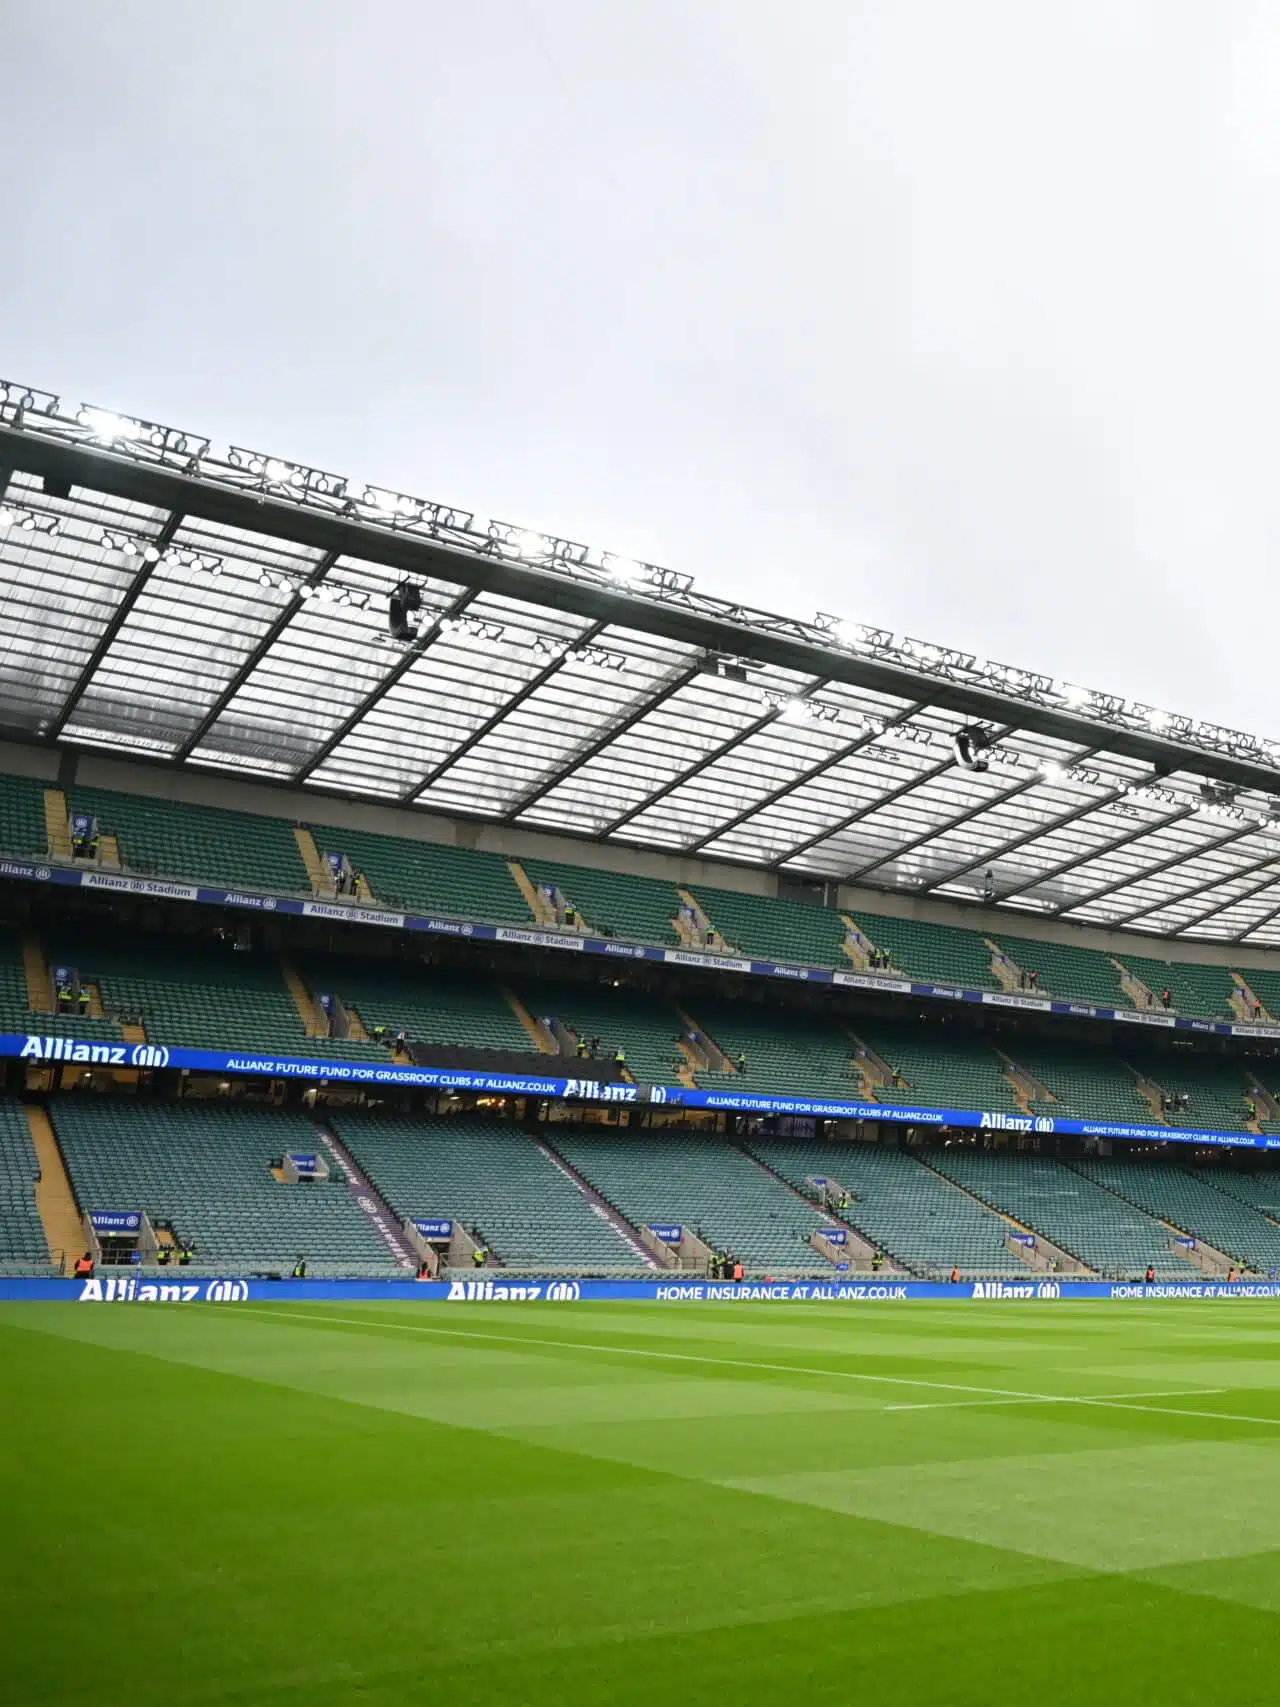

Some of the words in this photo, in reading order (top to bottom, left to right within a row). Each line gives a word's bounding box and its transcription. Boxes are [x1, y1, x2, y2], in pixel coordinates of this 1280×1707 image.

[0, 863, 33, 877] llianz
[89, 875, 128, 889] Allianz
[146, 882, 191, 897] Stadium
[224, 893, 262, 906] Allianz
[310, 904, 345, 918] Allianz
[359, 911, 399, 924] Stadium
[428, 920, 459, 933] Allianz
[501, 929, 532, 941] Allianz
[545, 935, 580, 948] Stadium
[605, 944, 633, 955] Allianz
[674, 953, 701, 964] Allianz
[712, 957, 743, 969] Stadium
[774, 966, 799, 977] Allianz
[843, 975, 866, 986] Allianz
[876, 979, 904, 990] Stadium
[932, 987, 954, 997] Allianz
[991, 995, 1011, 1005] Allianz
[1020, 998, 1044, 1008] Stadium
[1069, 1005, 1089, 1014] Allianz
[1121, 1012, 1141, 1021] Allianz
[1147, 1015, 1169, 1024] Stadium
[20, 1036, 126, 1064] Allianz
[227, 1059, 273, 1072] ALLIANZ
[275, 1063, 318, 1075] FUTURE
[320, 1066, 350, 1077] FUND
[352, 1069, 374, 1079] FOR
[376, 1071, 437, 1084] GRASSROOT
[440, 1076, 471, 1087] CLUBS
[473, 1078, 486, 1088] AT
[487, 1080, 556, 1093] ALLIANZ.CO.UK
[706, 1096, 740, 1106] ALLIANZ
[741, 1099, 771, 1109] FUTURE
[772, 1102, 794, 1111] FUND
[796, 1103, 812, 1112] FOR
[813, 1104, 857, 1115] GRASSROOT
[859, 1108, 881, 1117] CLUBS
[882, 1109, 892, 1118] AT
[892, 1110, 943, 1122] ALLIANZ.CO.UK
[980, 1112, 1032, 1132] Allianz
[1083, 1126, 1107, 1134] ALLIANZ
[1130, 1128, 1146, 1137] FUND
[1211, 1134, 1217, 1142] AT
[79, 1279, 200, 1301] Allianz
[447, 1282, 541, 1300] Allianz
[656, 1287, 703, 1300] HOME
[707, 1287, 789, 1300] INSURANCE
[792, 1287, 809, 1300] AT
[811, 1287, 906, 1300] ALLANZ.CO.UK
[972, 1283, 1034, 1299] Allianz
[1111, 1286, 1143, 1297] HOME
[1145, 1286, 1202, 1297] INSURANCE
[1203, 1286, 1215, 1297] AT
